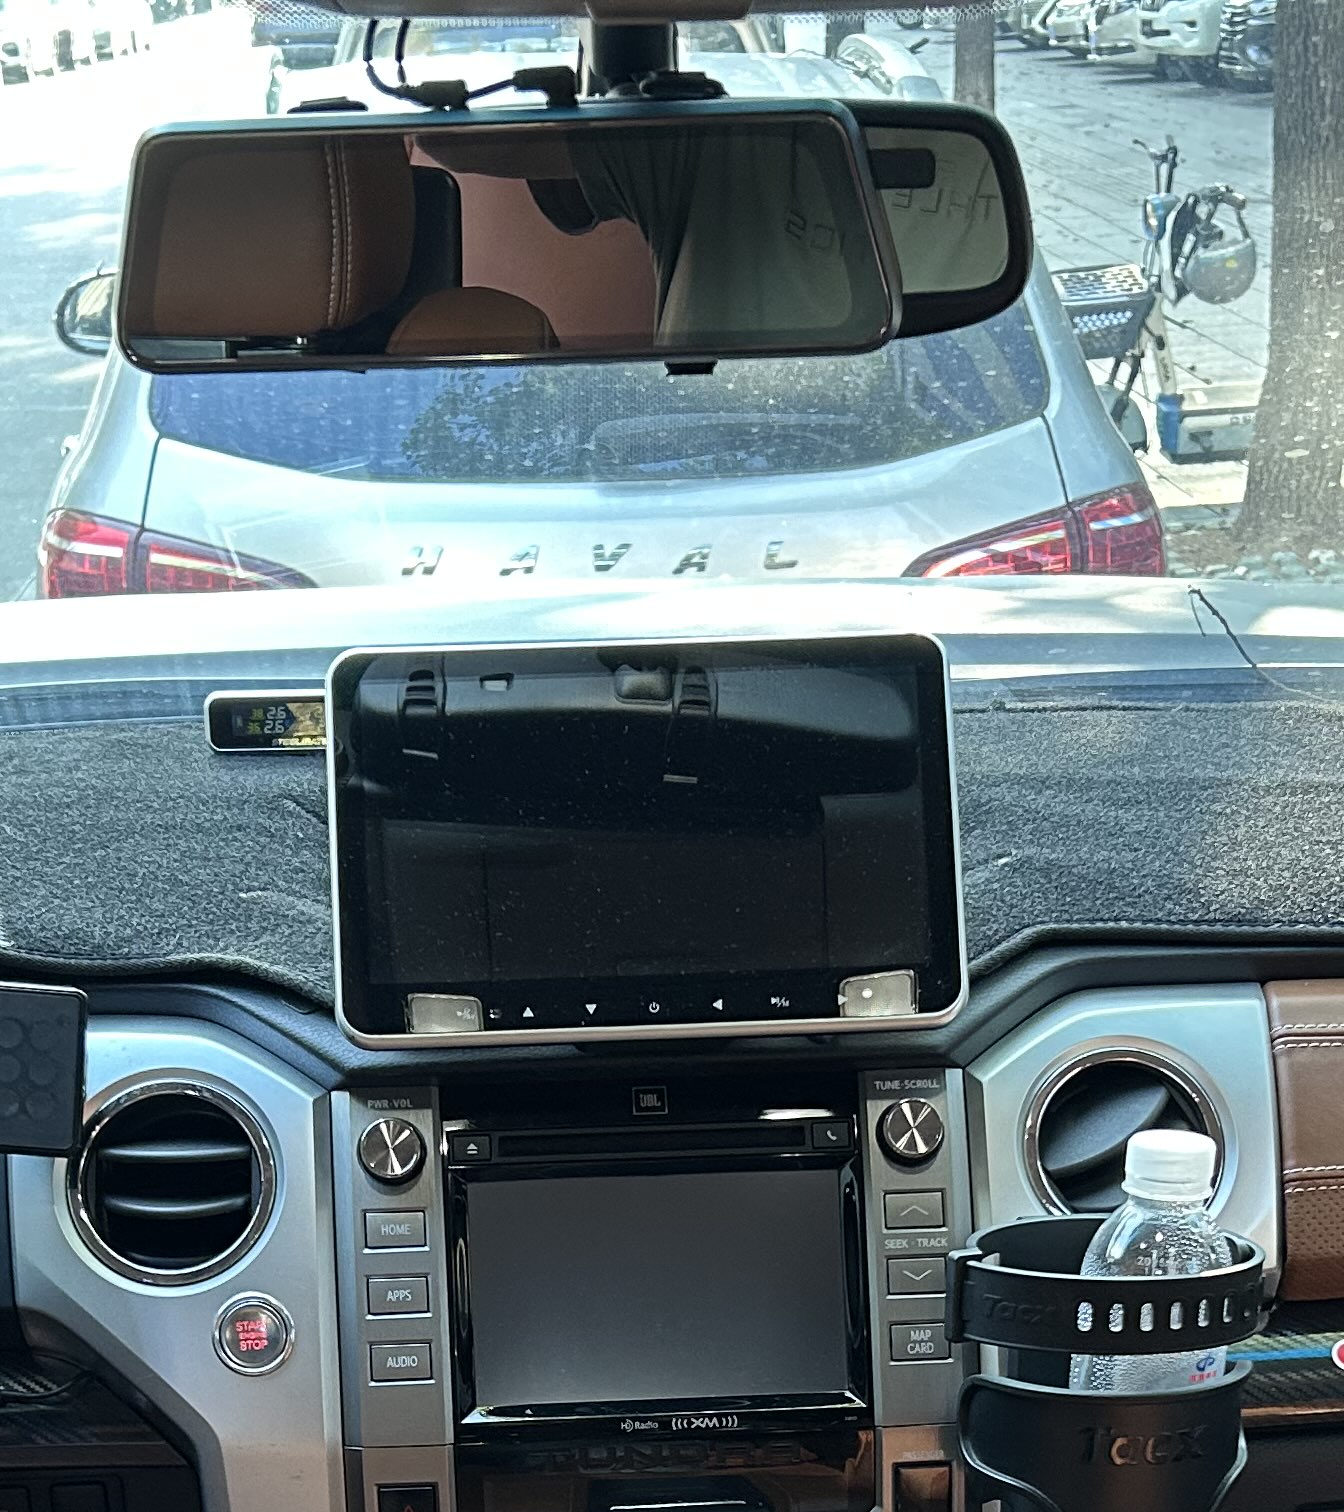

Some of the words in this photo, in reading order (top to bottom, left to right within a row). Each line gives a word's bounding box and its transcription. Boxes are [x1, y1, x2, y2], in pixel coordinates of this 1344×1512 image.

[401, 540, 799, 576] HAVAL
[639, 1093, 662, 1108] JBL
[380, 1224, 412, 1236] HOME
[884, 1239, 909, 1249] SEEK
[917, 1237, 948, 1248] TRACK
[386, 1290, 413, 1302] APPS
[910, 1329, 932, 1341] MAP
[239, 1340, 269, 1352] STOP
[907, 1342, 934, 1354] CARD
[386, 1356, 418, 1368] AUDIO
